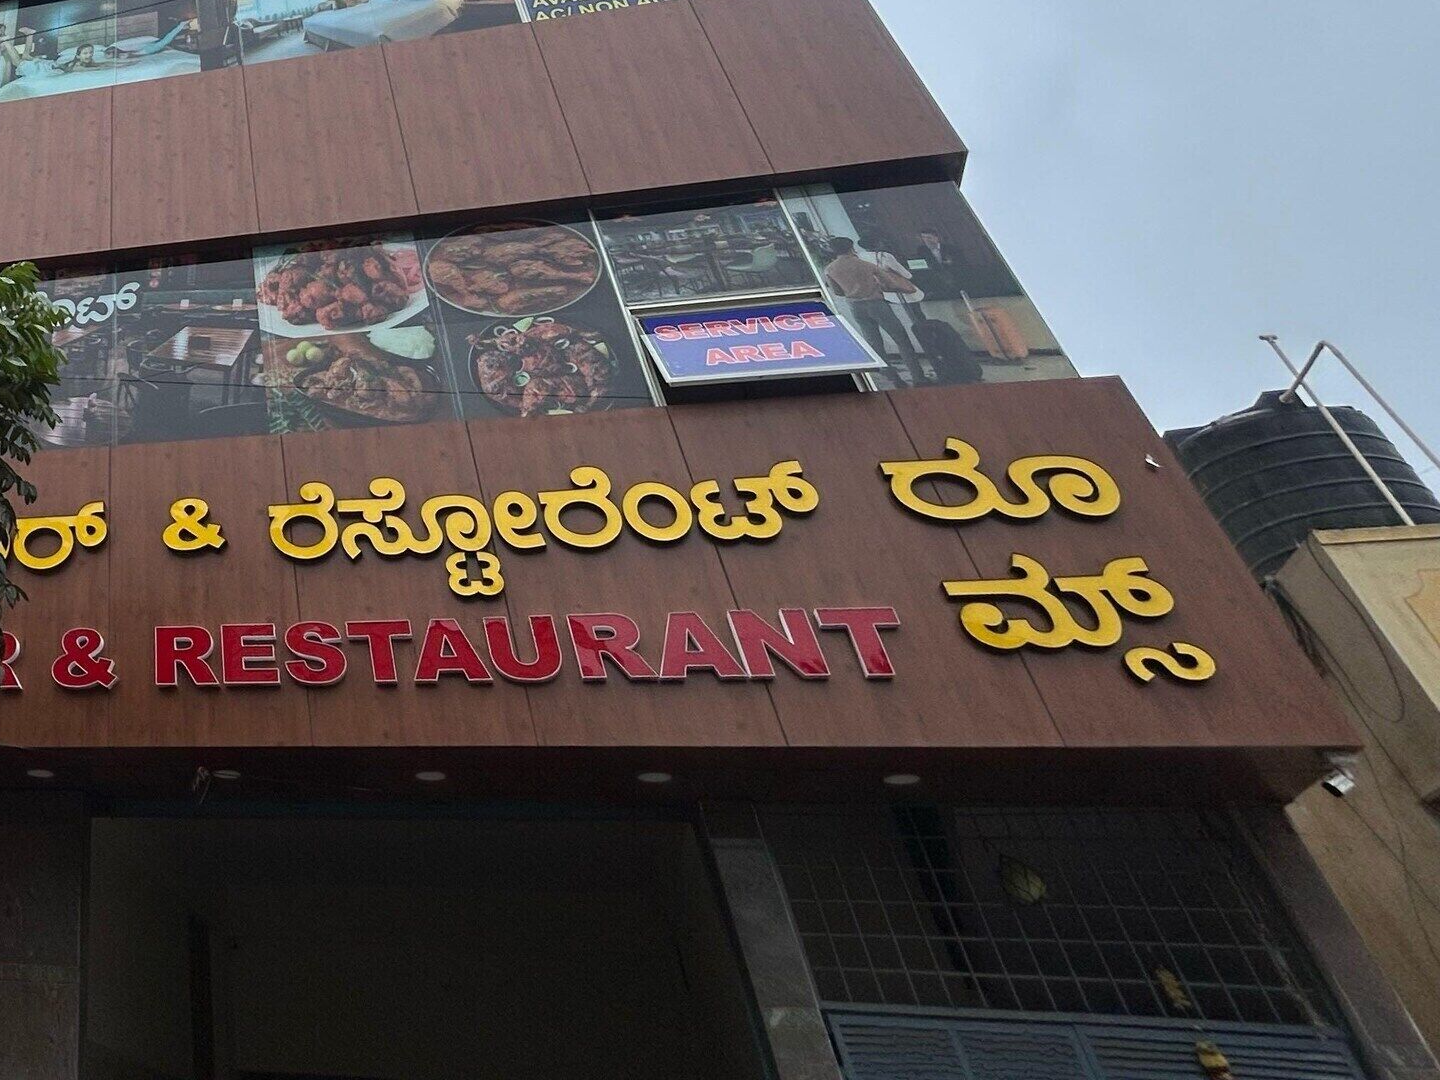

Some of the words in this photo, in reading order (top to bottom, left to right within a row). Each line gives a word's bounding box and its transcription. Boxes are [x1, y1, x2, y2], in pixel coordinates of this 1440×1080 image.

[654, 311, 837, 342] SERVICE
[705, 340, 825, 366] AREA
[162, 498, 227, 551] &
[268, 460, 820, 597] ರೆಸ್ಟೋರೆಂಟ್
[51, 627, 120, 689] &
[153, 605, 901, 687] RESTAURANT
